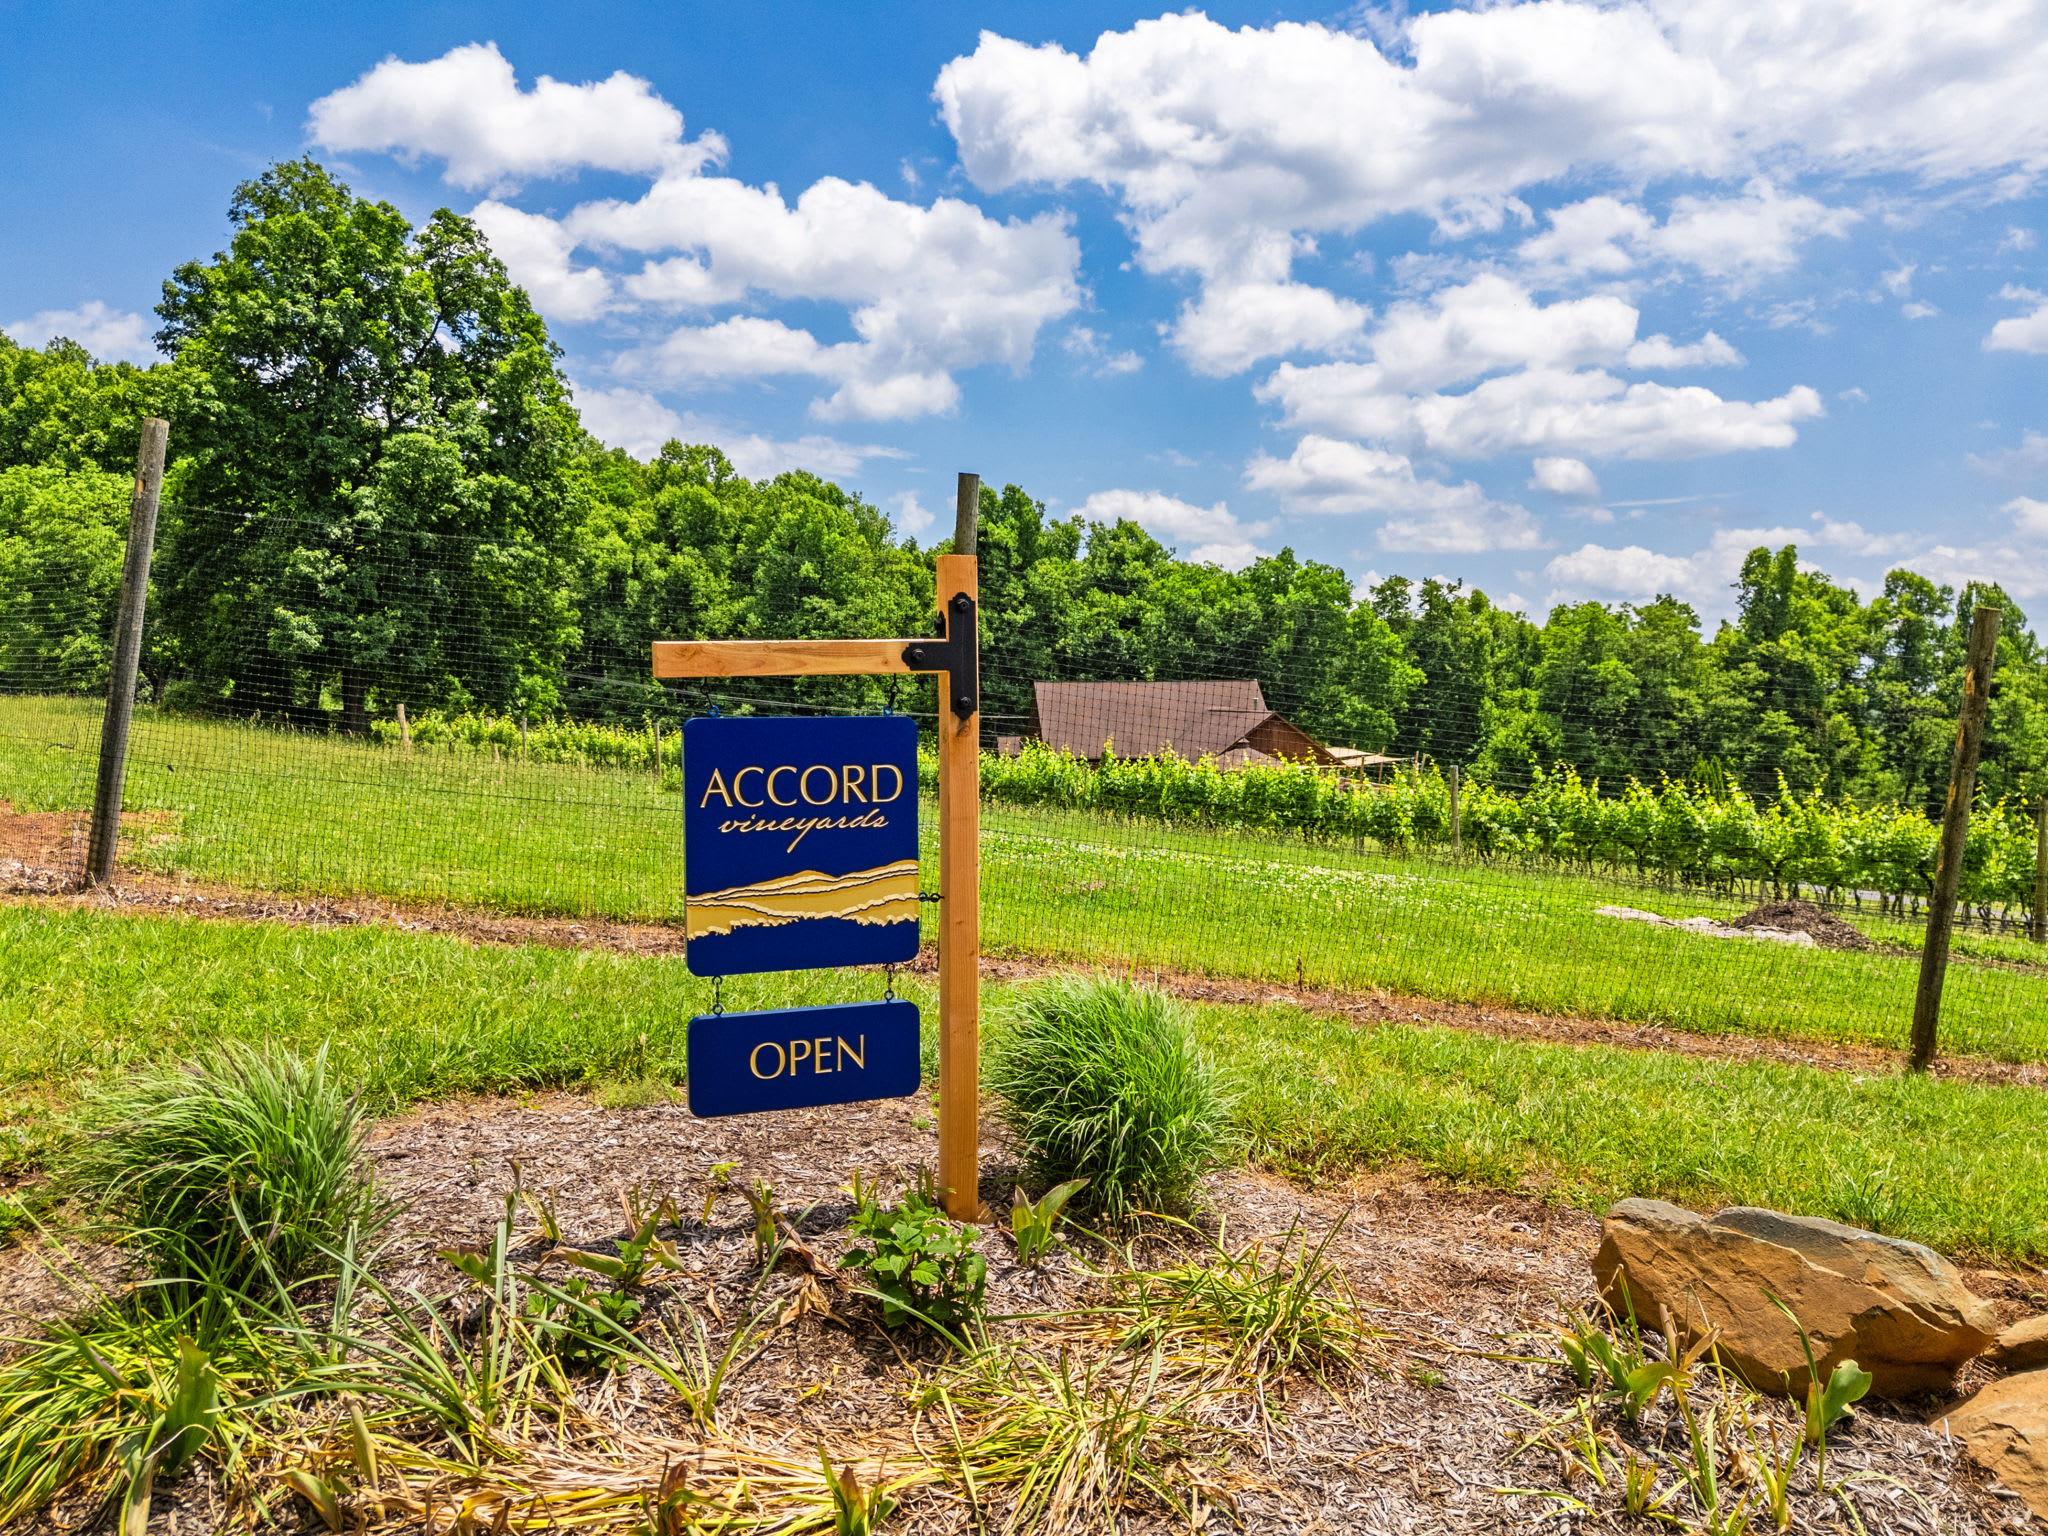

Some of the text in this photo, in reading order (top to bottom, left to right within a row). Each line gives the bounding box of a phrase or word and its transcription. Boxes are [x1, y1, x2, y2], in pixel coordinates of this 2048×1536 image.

[700, 764, 904, 809] ACCORD
[718, 808, 889, 854] vineyards
[749, 1034, 866, 1080] OPEN
